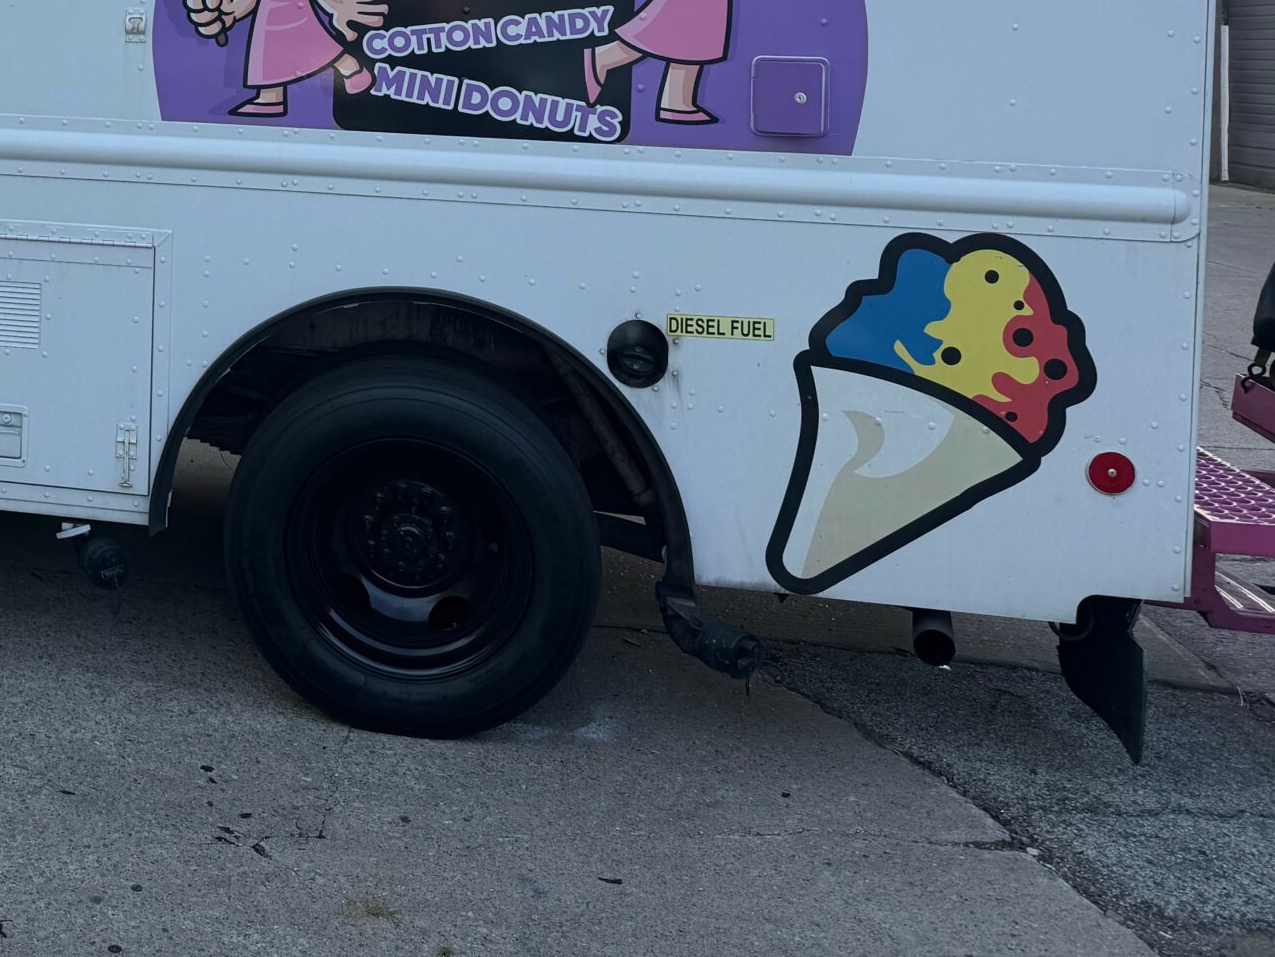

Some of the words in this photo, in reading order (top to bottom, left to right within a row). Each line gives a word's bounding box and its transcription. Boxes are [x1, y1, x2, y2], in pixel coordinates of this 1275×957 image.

[364, 21, 495, 56] COTTON
[499, 7, 611, 43] CANDY
[373, 64, 456, 107] MINI
[459, 80, 621, 139] DONUTS
[668, 316, 726, 336] DIESEL
[730, 319, 773, 339] FUEL
